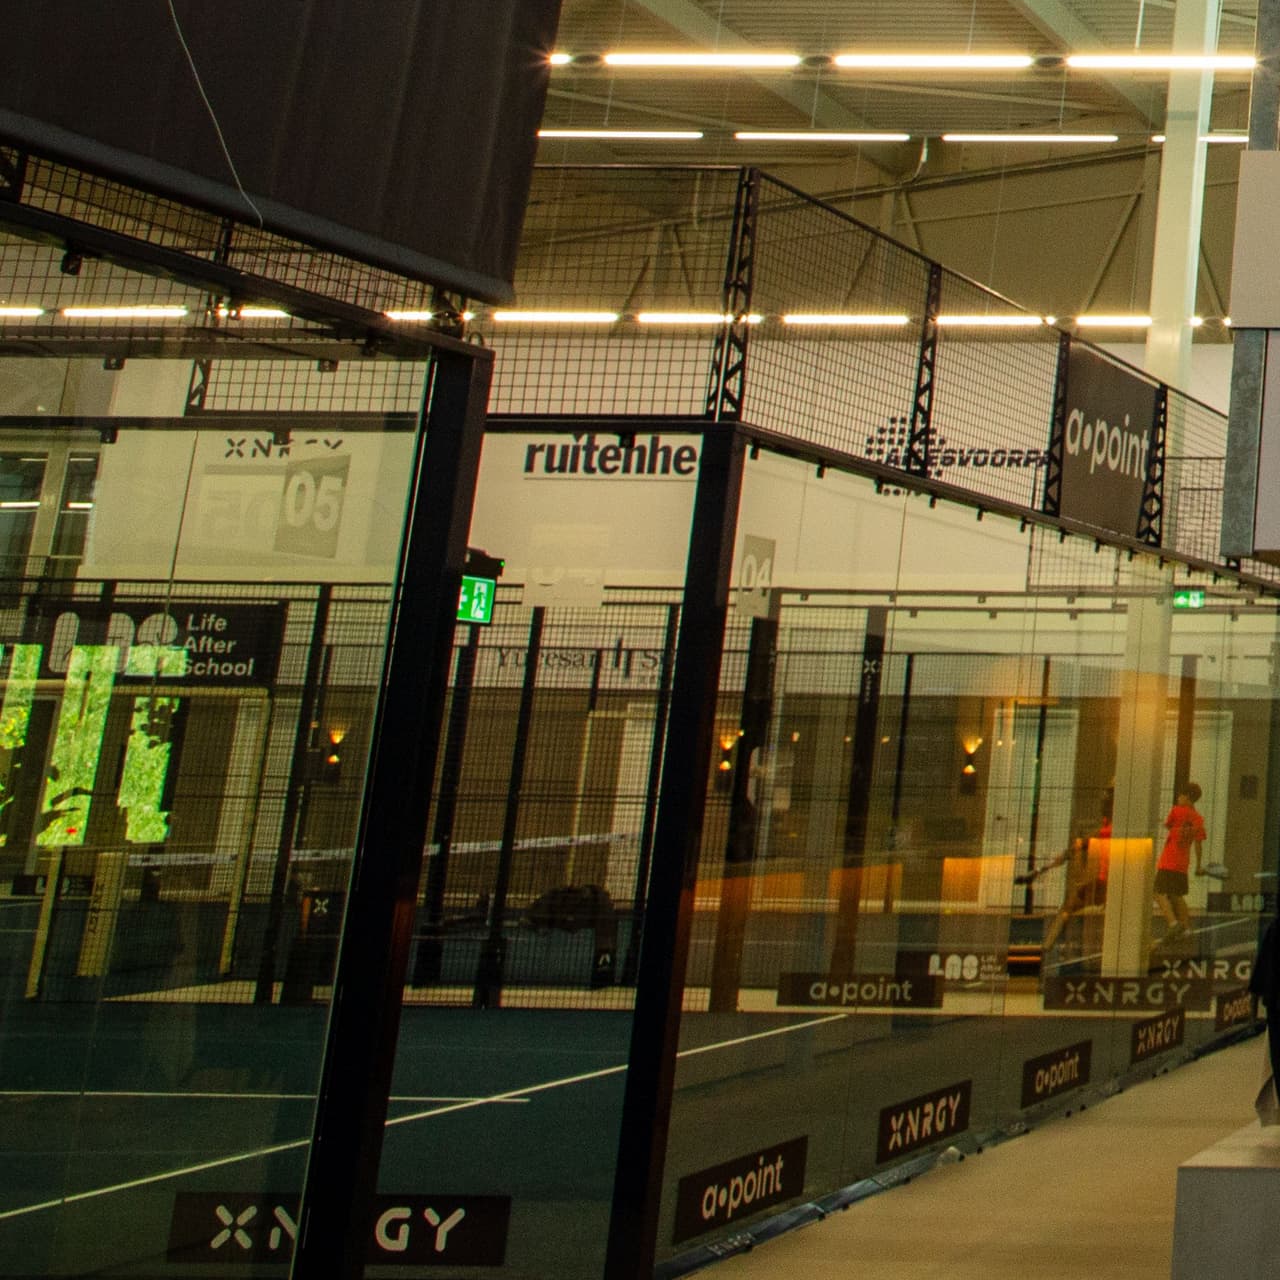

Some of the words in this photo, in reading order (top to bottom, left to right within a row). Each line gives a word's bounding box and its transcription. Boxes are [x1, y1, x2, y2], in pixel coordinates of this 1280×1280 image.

[286, 470, 343, 532] 05
[187, 613, 228, 632] Life
[184, 635, 238, 655] After
[182, 657, 255, 677] School
[1063, 981, 1192, 1005] XNRGY
[1136, 1014, 1180, 1056] XNRGY
[887, 1091, 962, 1151] XNRGY
[210, 1204, 466, 1252] XNGY
